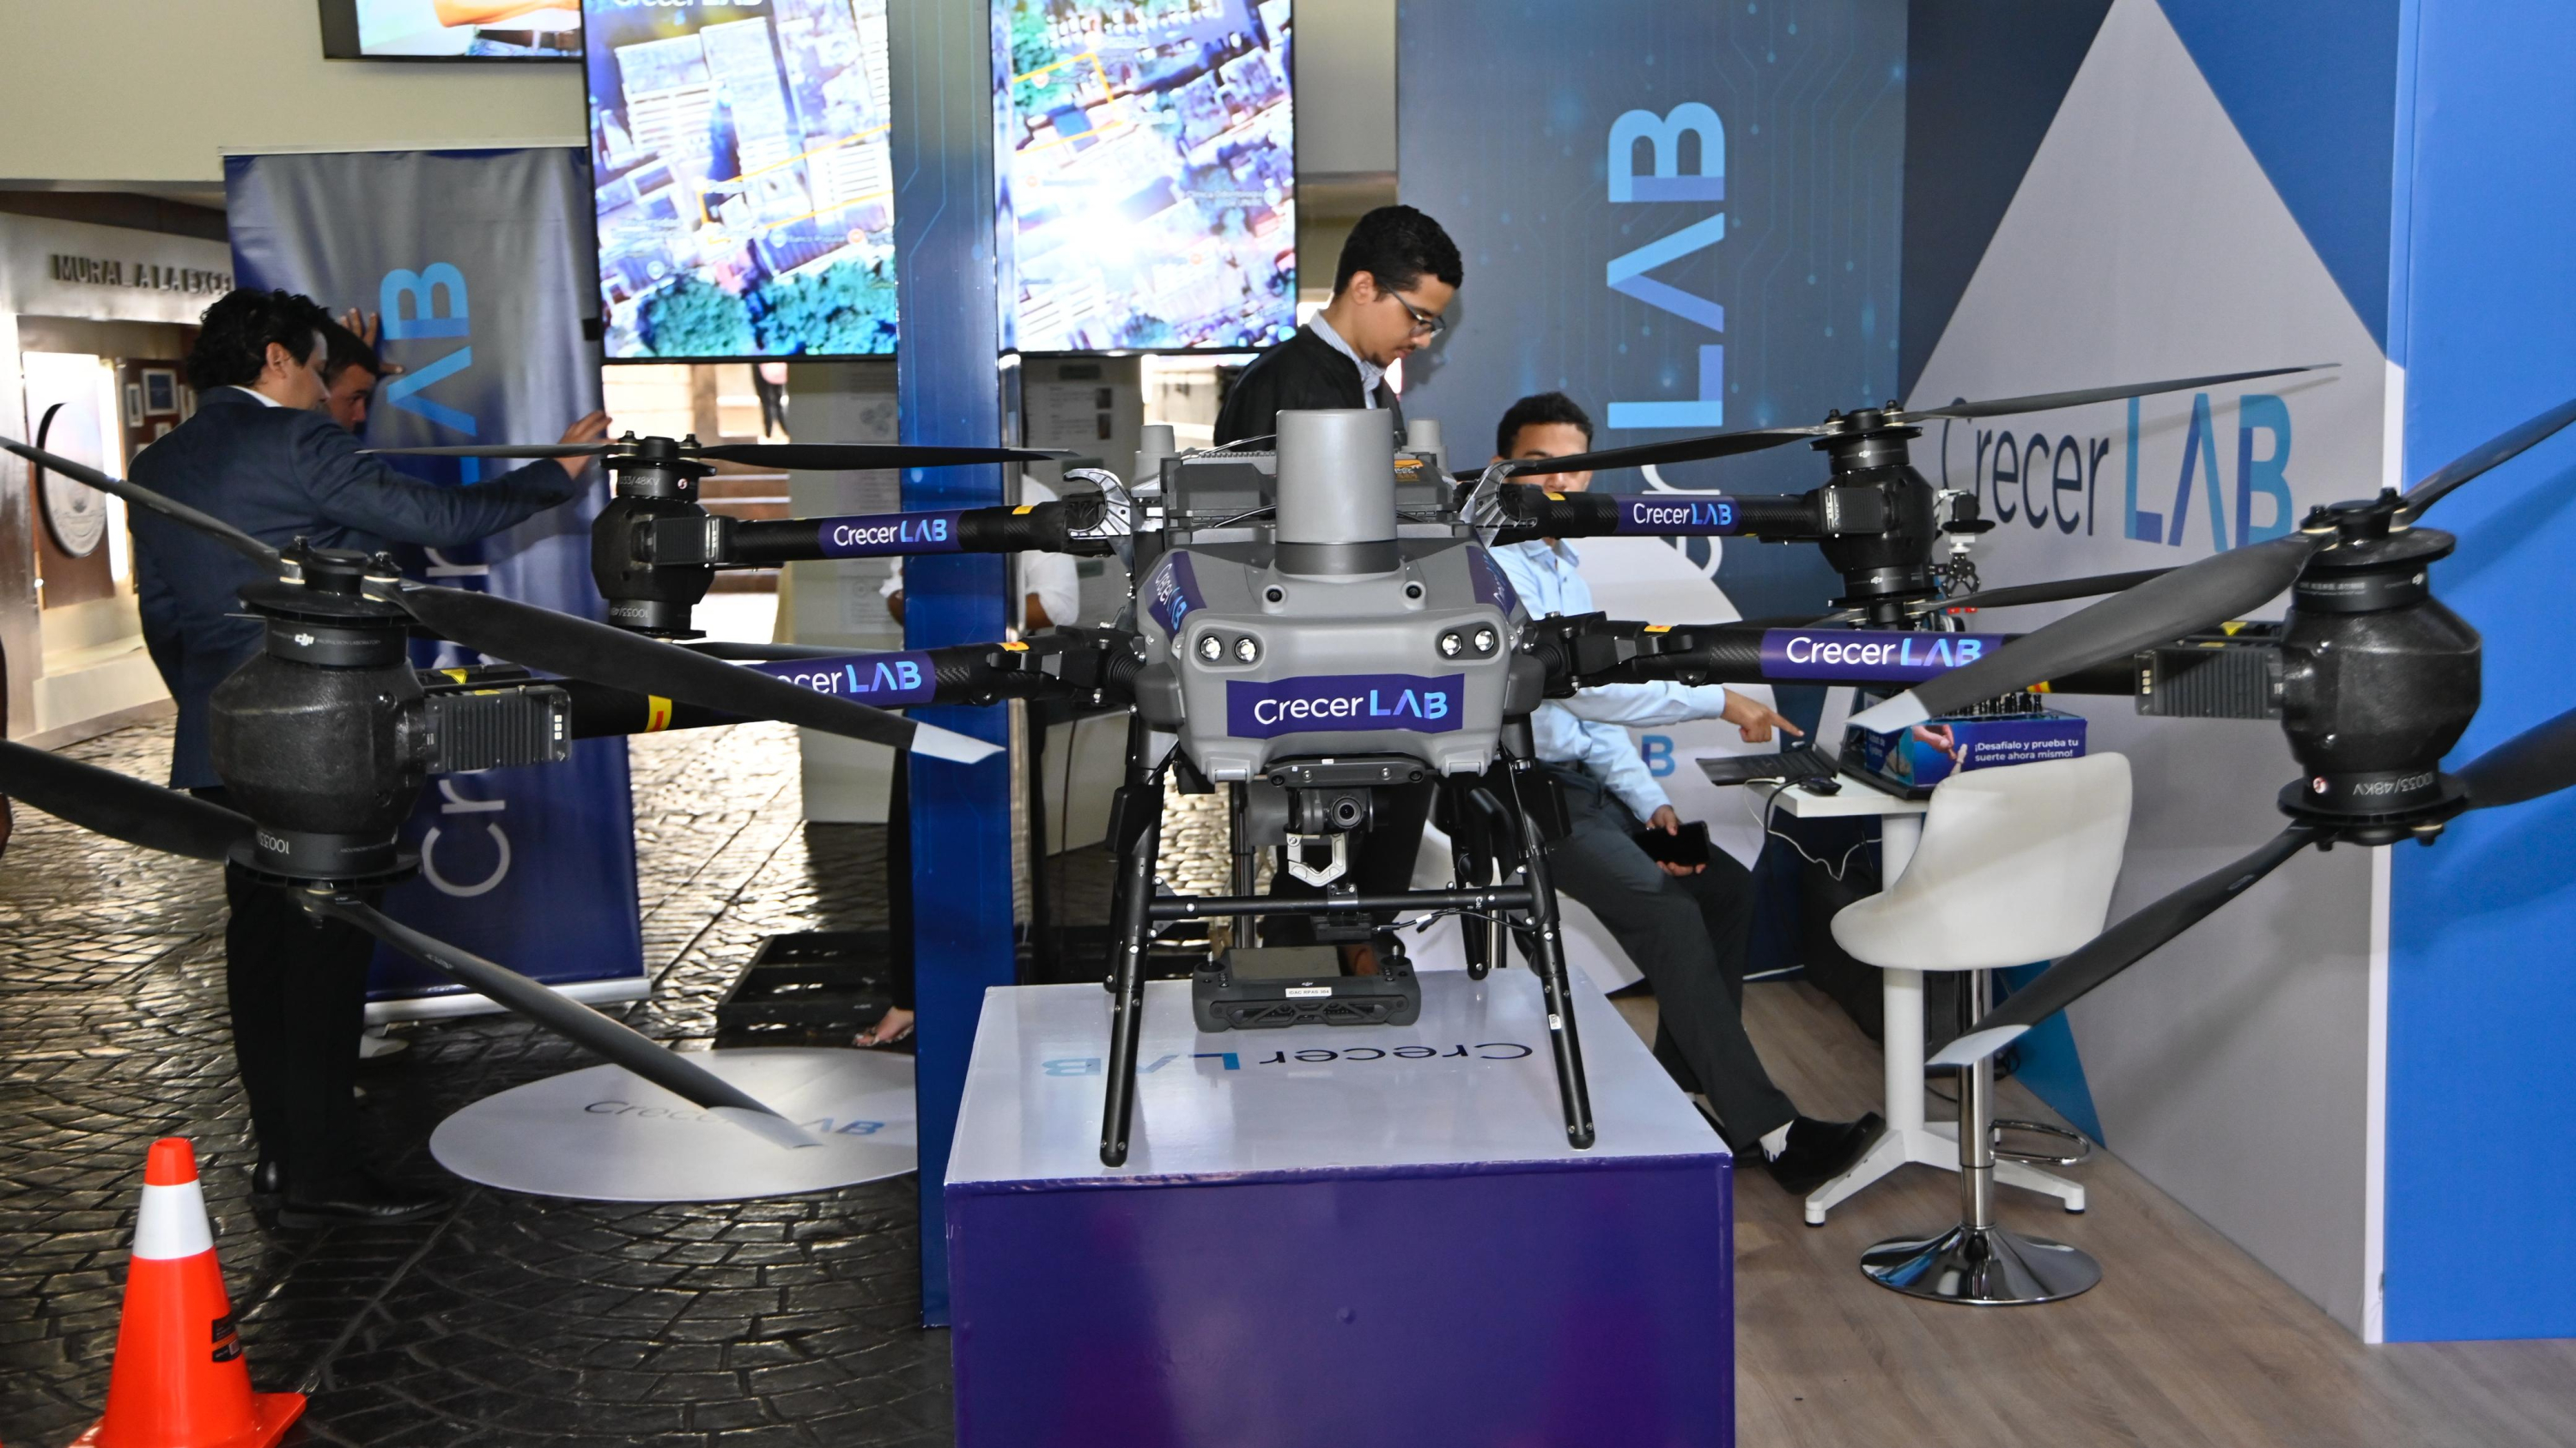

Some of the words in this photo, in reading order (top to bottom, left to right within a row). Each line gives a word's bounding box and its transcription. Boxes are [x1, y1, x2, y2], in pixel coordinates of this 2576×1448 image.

[50, 254, 132, 287] MURAL
[1607, 101, 1725, 429] LAB
[2123, 392, 2293, 553] LAB
[1633, 502, 1690, 524] Crecer
[1691, 502, 1733, 525] LAB
[833, 525, 898, 546] Crecer
[900, 519, 947, 542] LAB
[1786, 636, 1896, 665] Crecer
[1900, 637, 1983, 667] LAB
[845, 660, 922, 694] LAB
[1254, 697, 1364, 725] Crecer
[1370, 689, 1448, 720] LAB
[1975, 753, 2006, 762] suerte
[2008, 751, 2035, 760] ahora
[2037, 749, 2074, 758] mismo!
[2023, 741, 2030, 751] y
[2032, 739, 2066, 750] prueba
[2068, 739, 2079, 747] tu
[1259, 1042, 1534, 1065] Crecer
